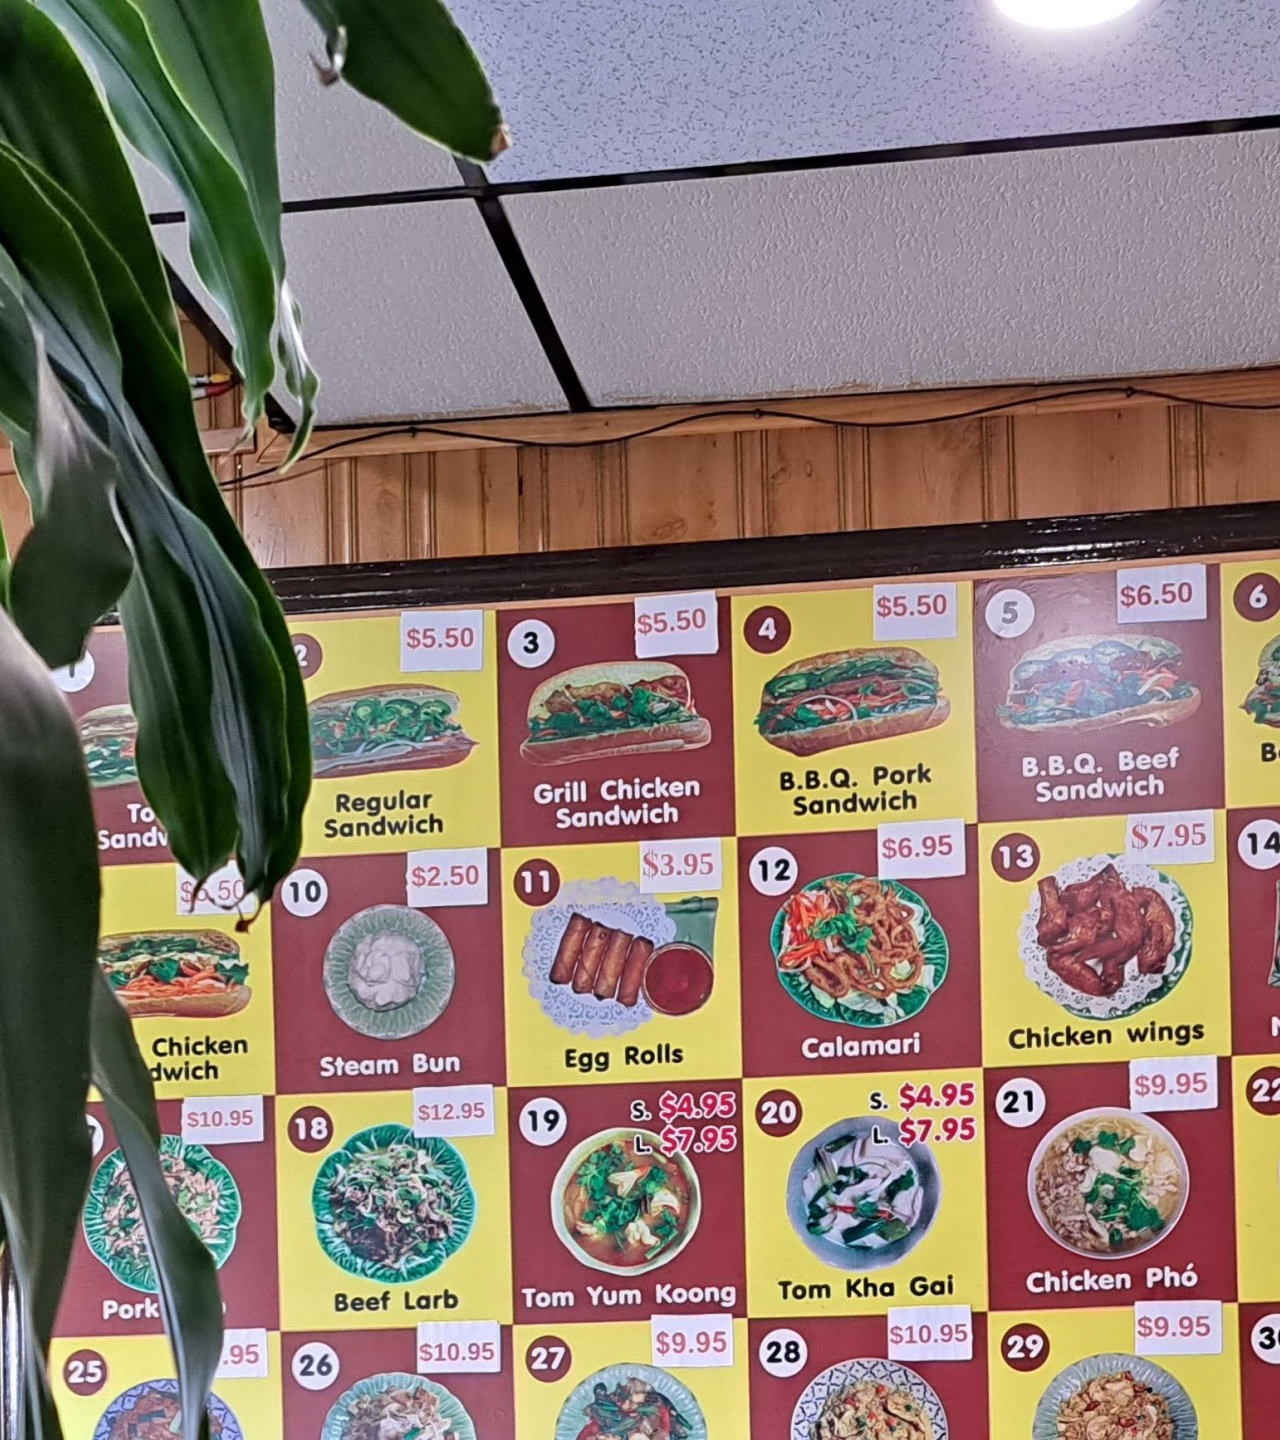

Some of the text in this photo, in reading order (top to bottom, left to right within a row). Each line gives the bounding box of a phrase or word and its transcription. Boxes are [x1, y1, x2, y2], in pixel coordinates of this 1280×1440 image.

[1120, 582, 1193, 608] $6.50
[406, 626, 474, 649] $5.50
[523, 632, 539, 654] 3
[1022, 748, 1179, 777] B.B.Q. Beef
[779, 764, 932, 790] B.B.Q. Pork
[1036, 776, 1164, 803] Sandwich
[335, 789, 432, 815] Regular
[534, 777, 700, 804] Grill Chicken
[793, 790, 917, 816] Sandwich
[324, 815, 443, 838] Sandwich
[556, 803, 679, 829] Sandwich
[881, 834, 953, 859] $6.95
[758, 859, 790, 881] 12
[152, 1036, 248, 1058] Chicken
[801, 1033, 920, 1059] Calamari
[1009, 1022, 1204, 1049] Chicken wings
[320, 1054, 460, 1077] Steam Bun
[564, 1043, 683, 1071] Egg Rolls
[870, 1083, 976, 1110] S. $4.95
[418, 1103, 485, 1121] $12.95
[761, 1101, 796, 1124] 20
[873, 1118, 976, 1146] L. $7.95
[778, 1275, 954, 1300] Tom Kha Gai
[1026, 1263, 1198, 1292] Chicken Phó
[335, 1289, 458, 1312] Beef Larb
[522, 1285, 737, 1308] Tom Yum Koong
[103, 1299, 158, 1320] Pork
[656, 1331, 727, 1356] $9.95
